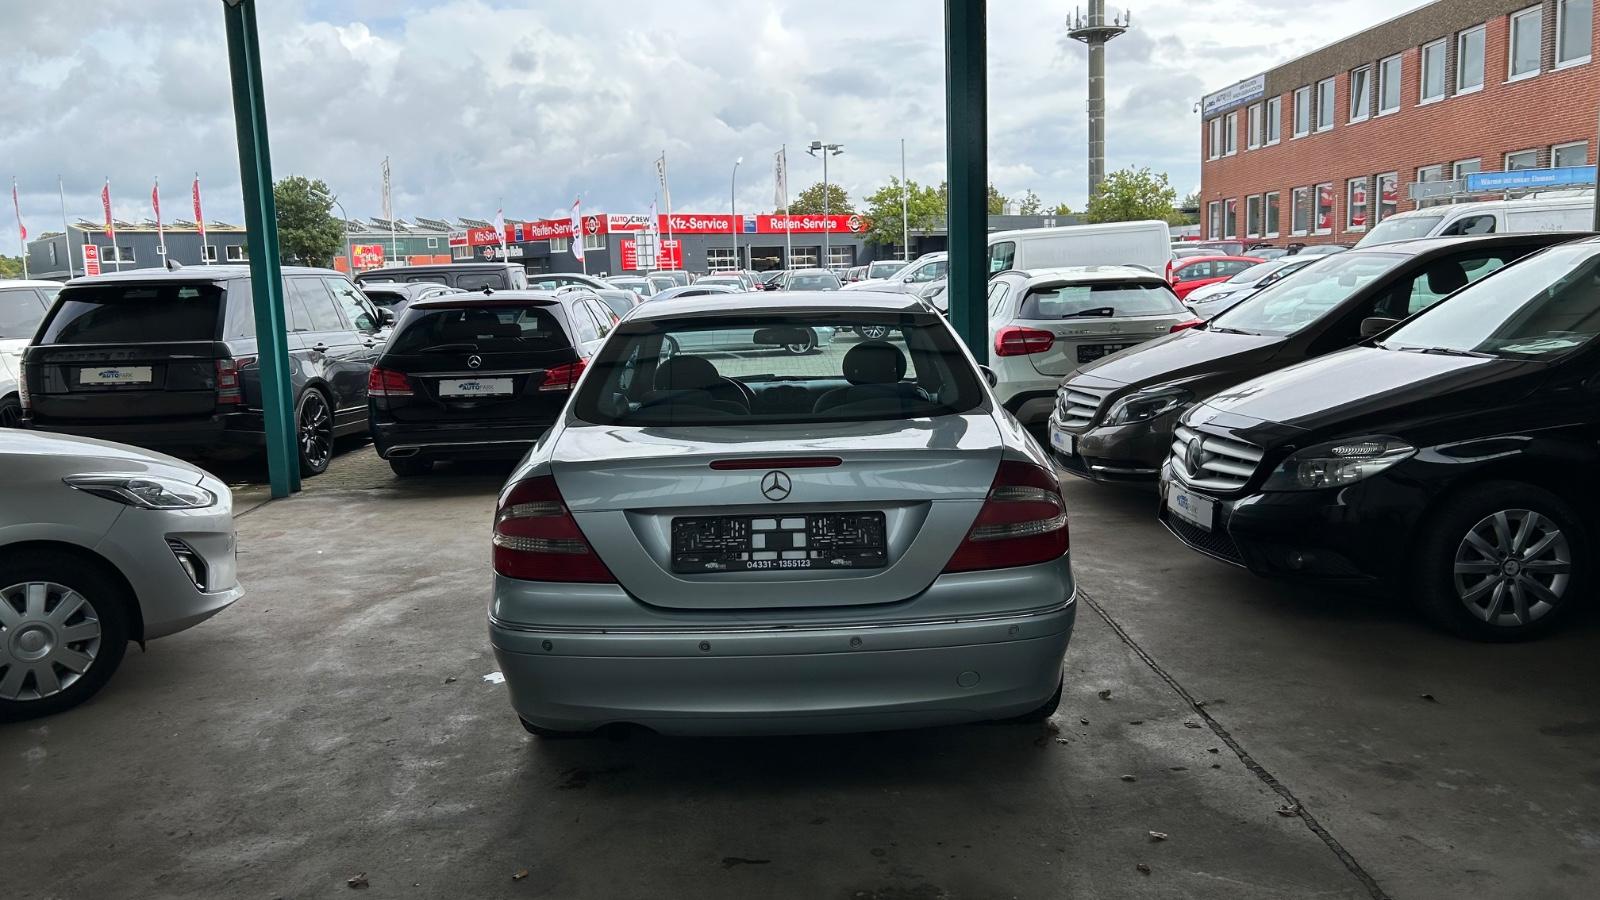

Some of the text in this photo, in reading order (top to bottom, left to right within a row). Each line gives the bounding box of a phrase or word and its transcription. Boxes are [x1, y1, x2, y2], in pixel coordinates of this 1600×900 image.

[670, 217, 728, 229] Kfz-Service
[770, 218, 837, 229] Reifen-Service
[532, 221, 573, 237] Reifen-Servi
[779, 560, 811, 568] 1355123
